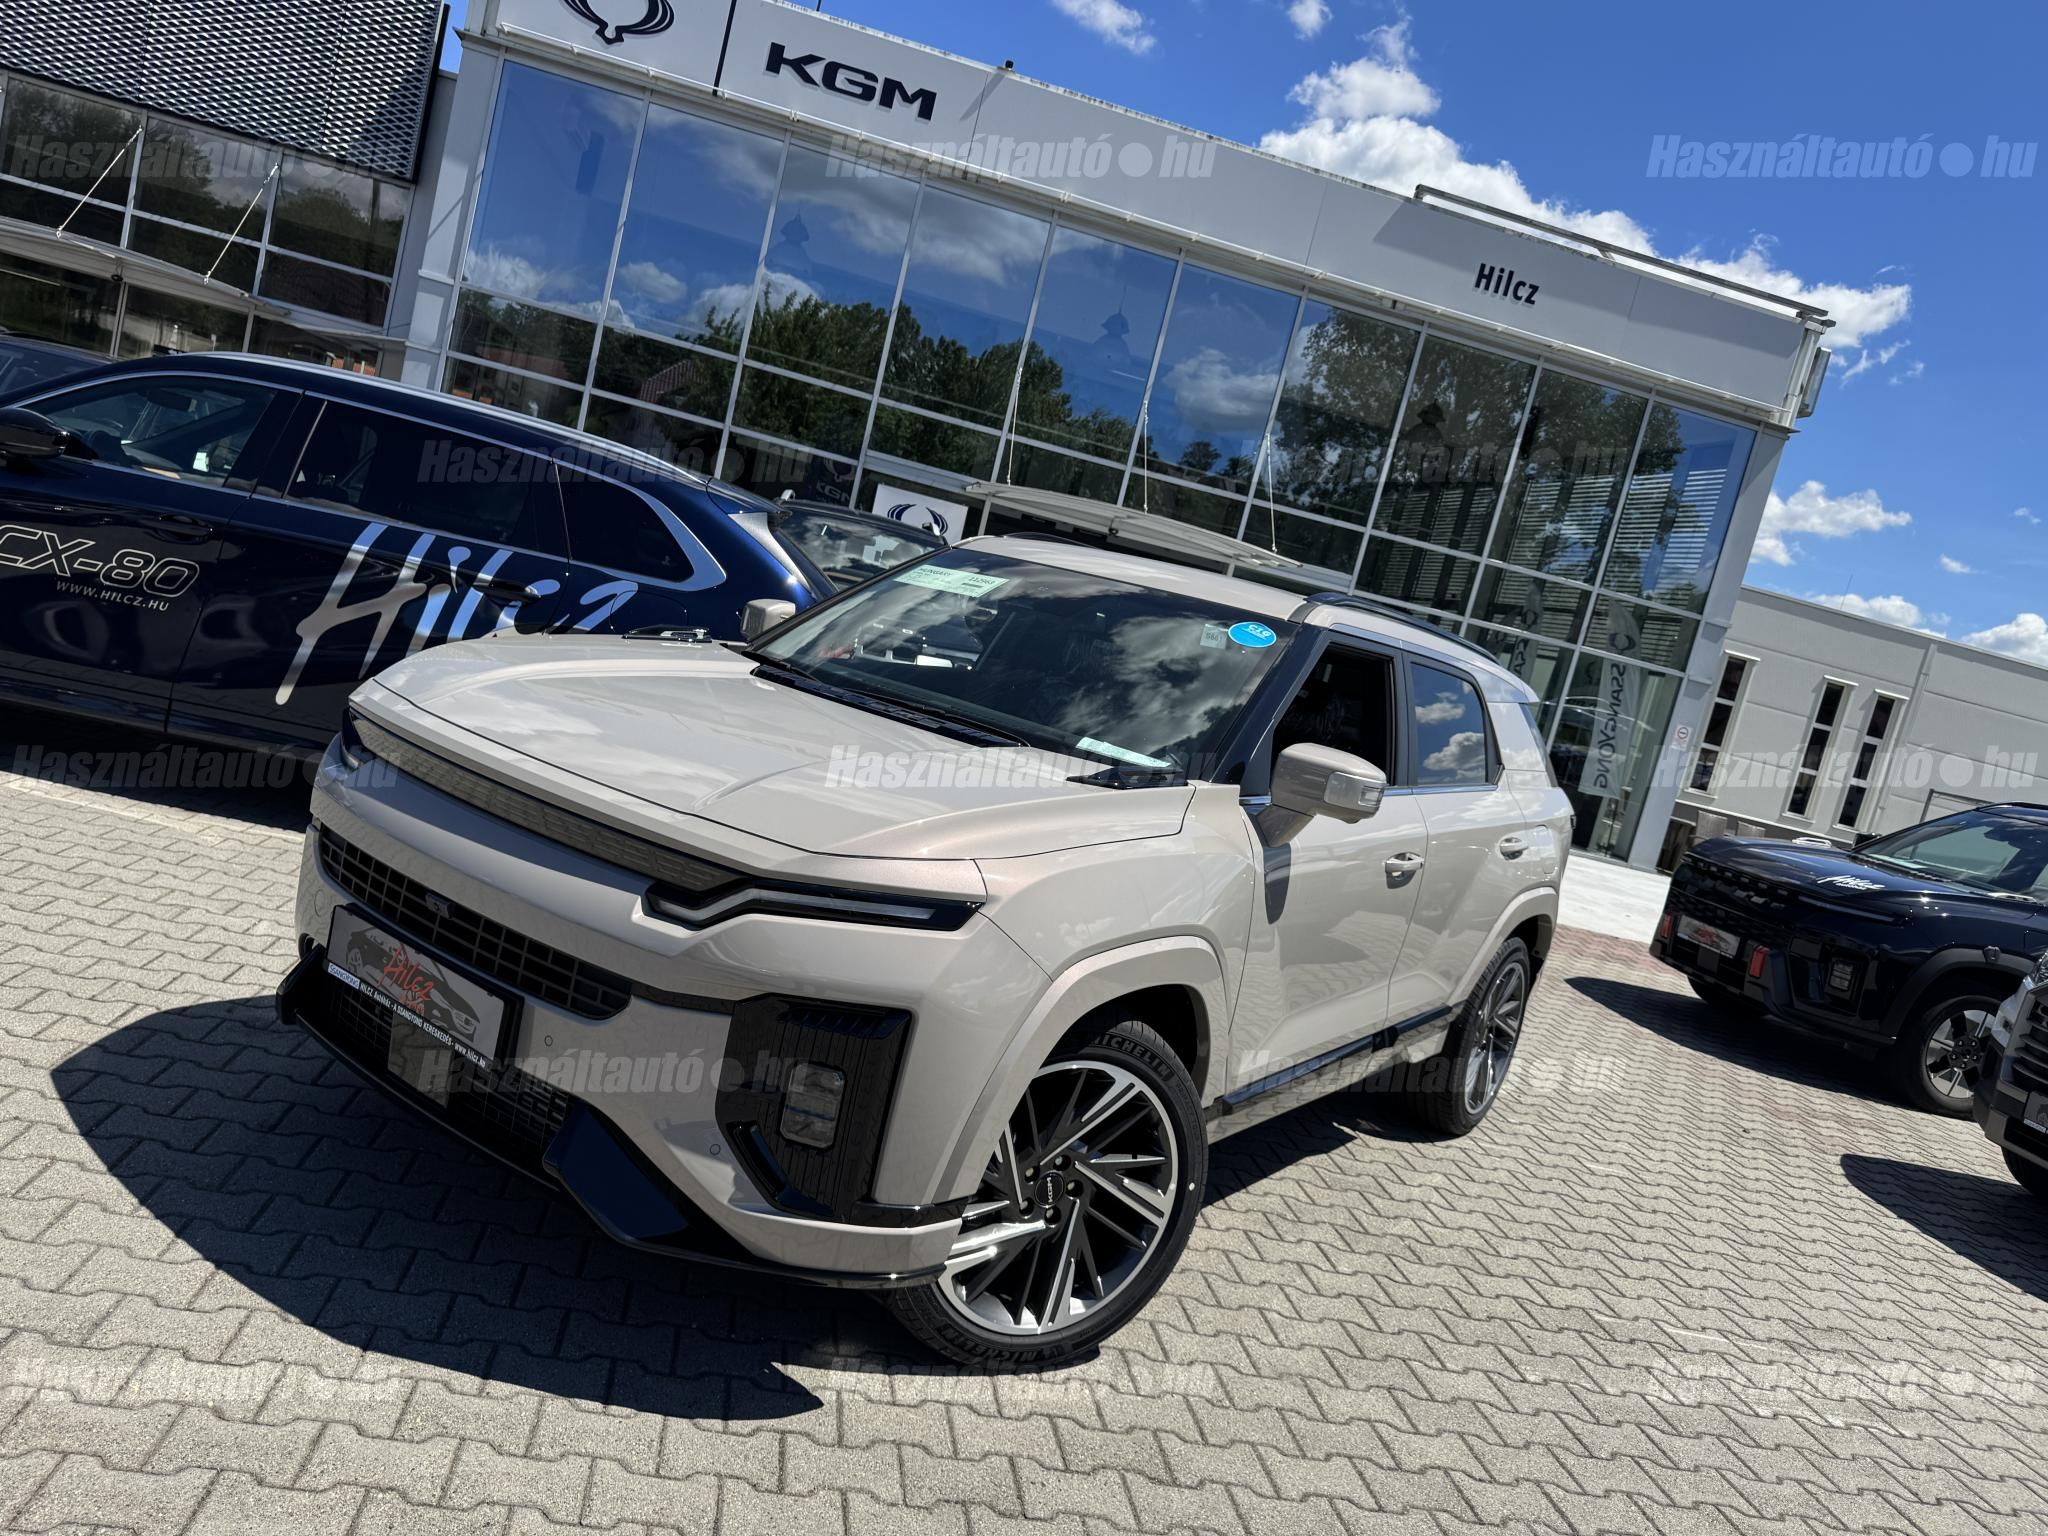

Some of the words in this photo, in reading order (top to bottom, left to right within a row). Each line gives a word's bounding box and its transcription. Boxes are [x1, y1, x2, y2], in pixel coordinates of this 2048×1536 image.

[765, 41, 937, 121] KGM
[1474, 262, 1540, 305] Hilcz
[0, 525, 200, 597] CX-80
[56, 580, 169, 612] WWW.HILCZ.HU
